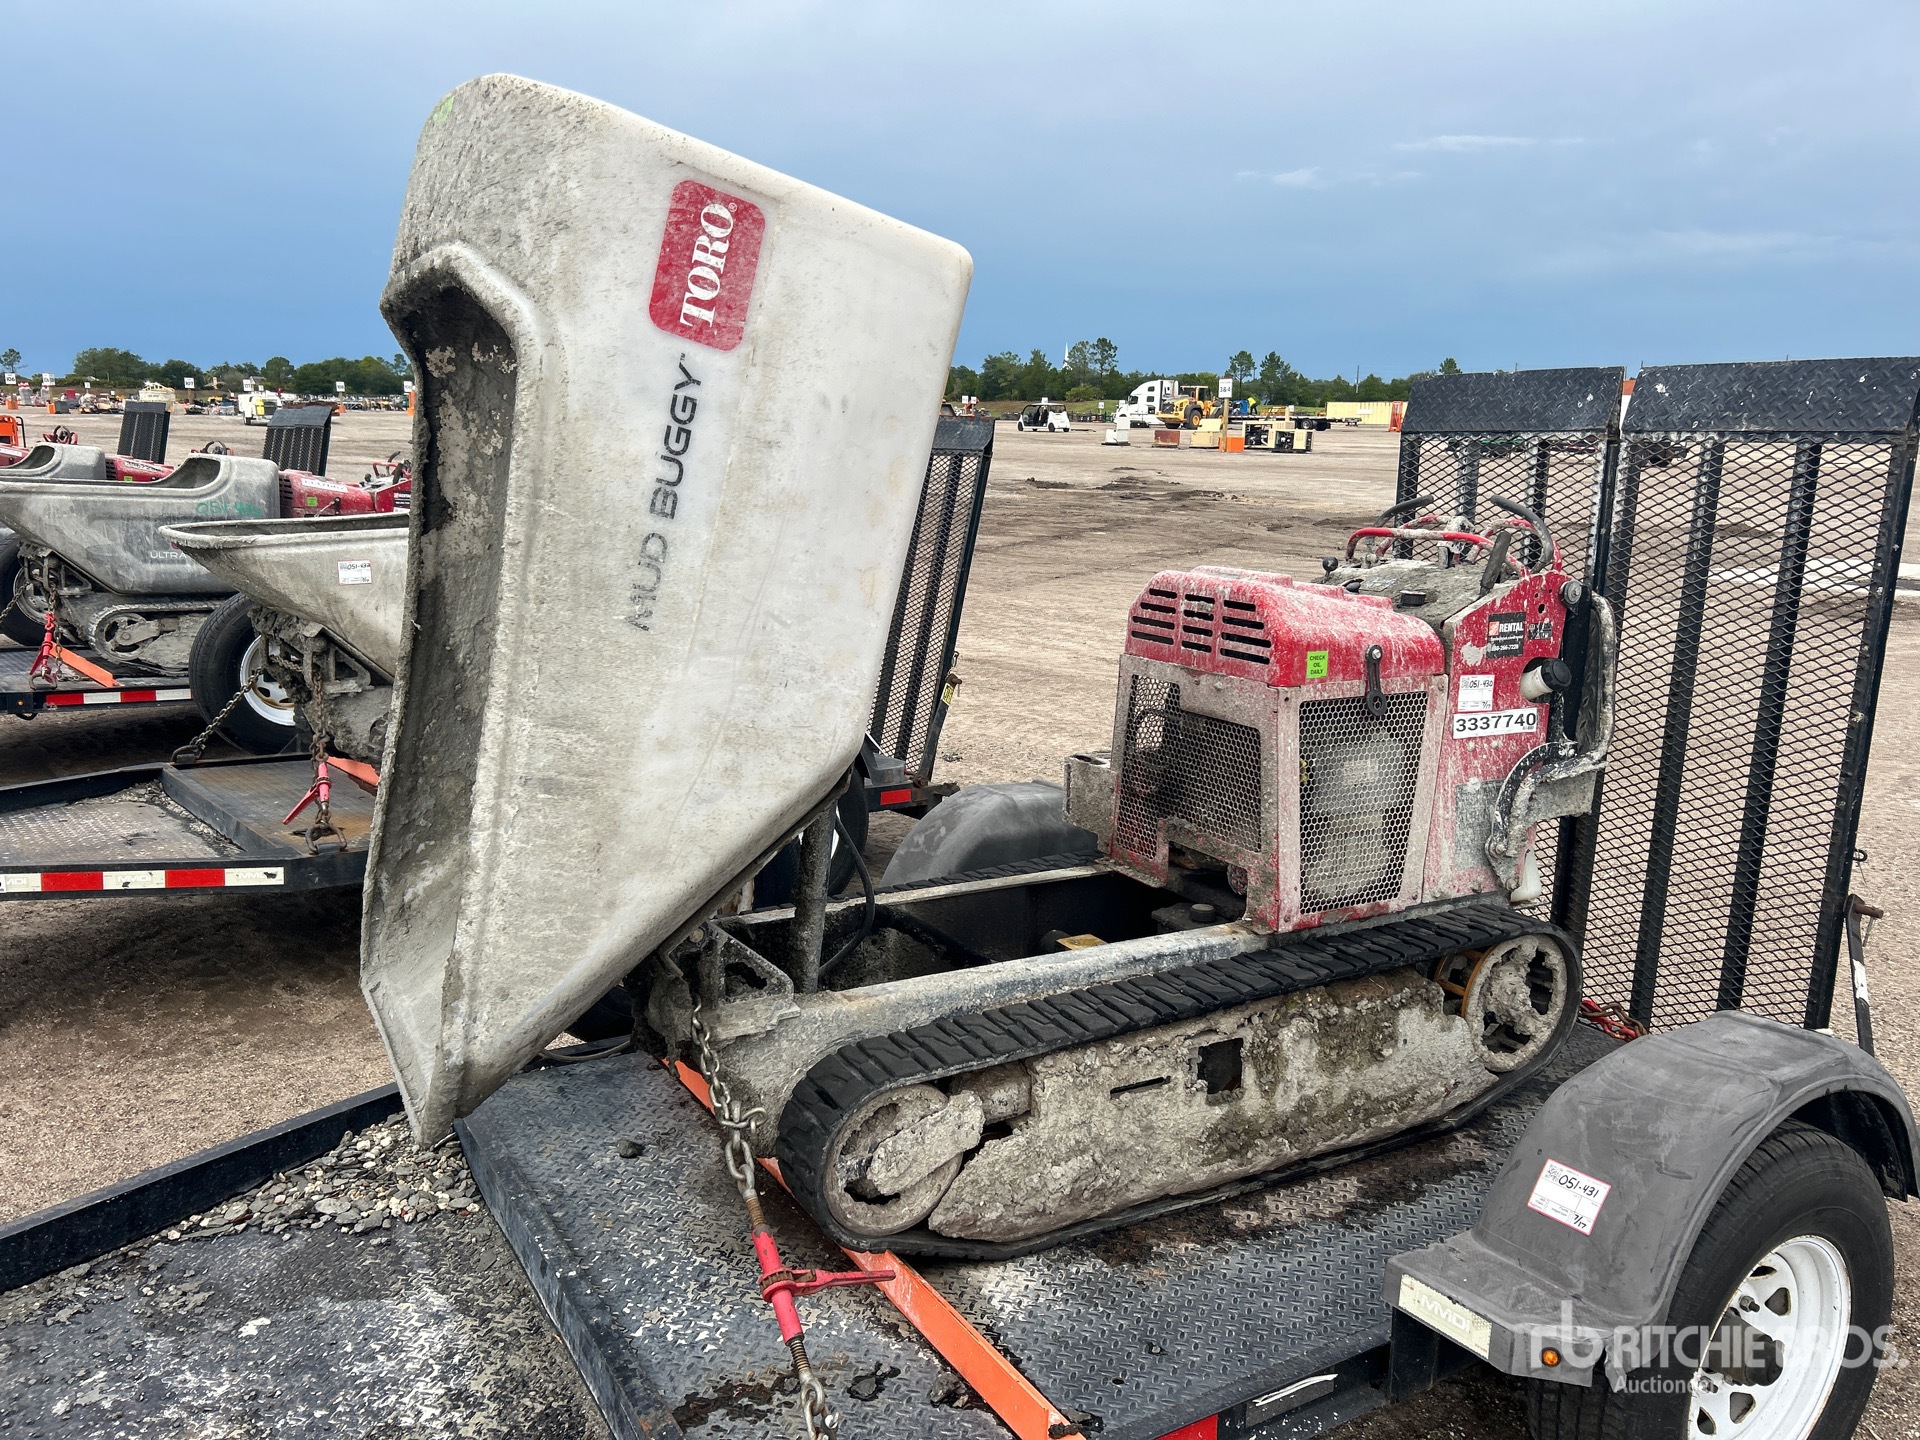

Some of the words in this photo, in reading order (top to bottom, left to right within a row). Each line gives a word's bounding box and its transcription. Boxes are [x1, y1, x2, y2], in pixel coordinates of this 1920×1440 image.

[680, 203, 734, 328] TORO
[625, 532, 668, 632] MUD
[649, 361, 701, 520] BUGGY
[1499, 622, 1524, 633] RENTAL
[1456, 712, 1537, 733] 3337740
[1558, 1174, 1600, 1198] 051-431
